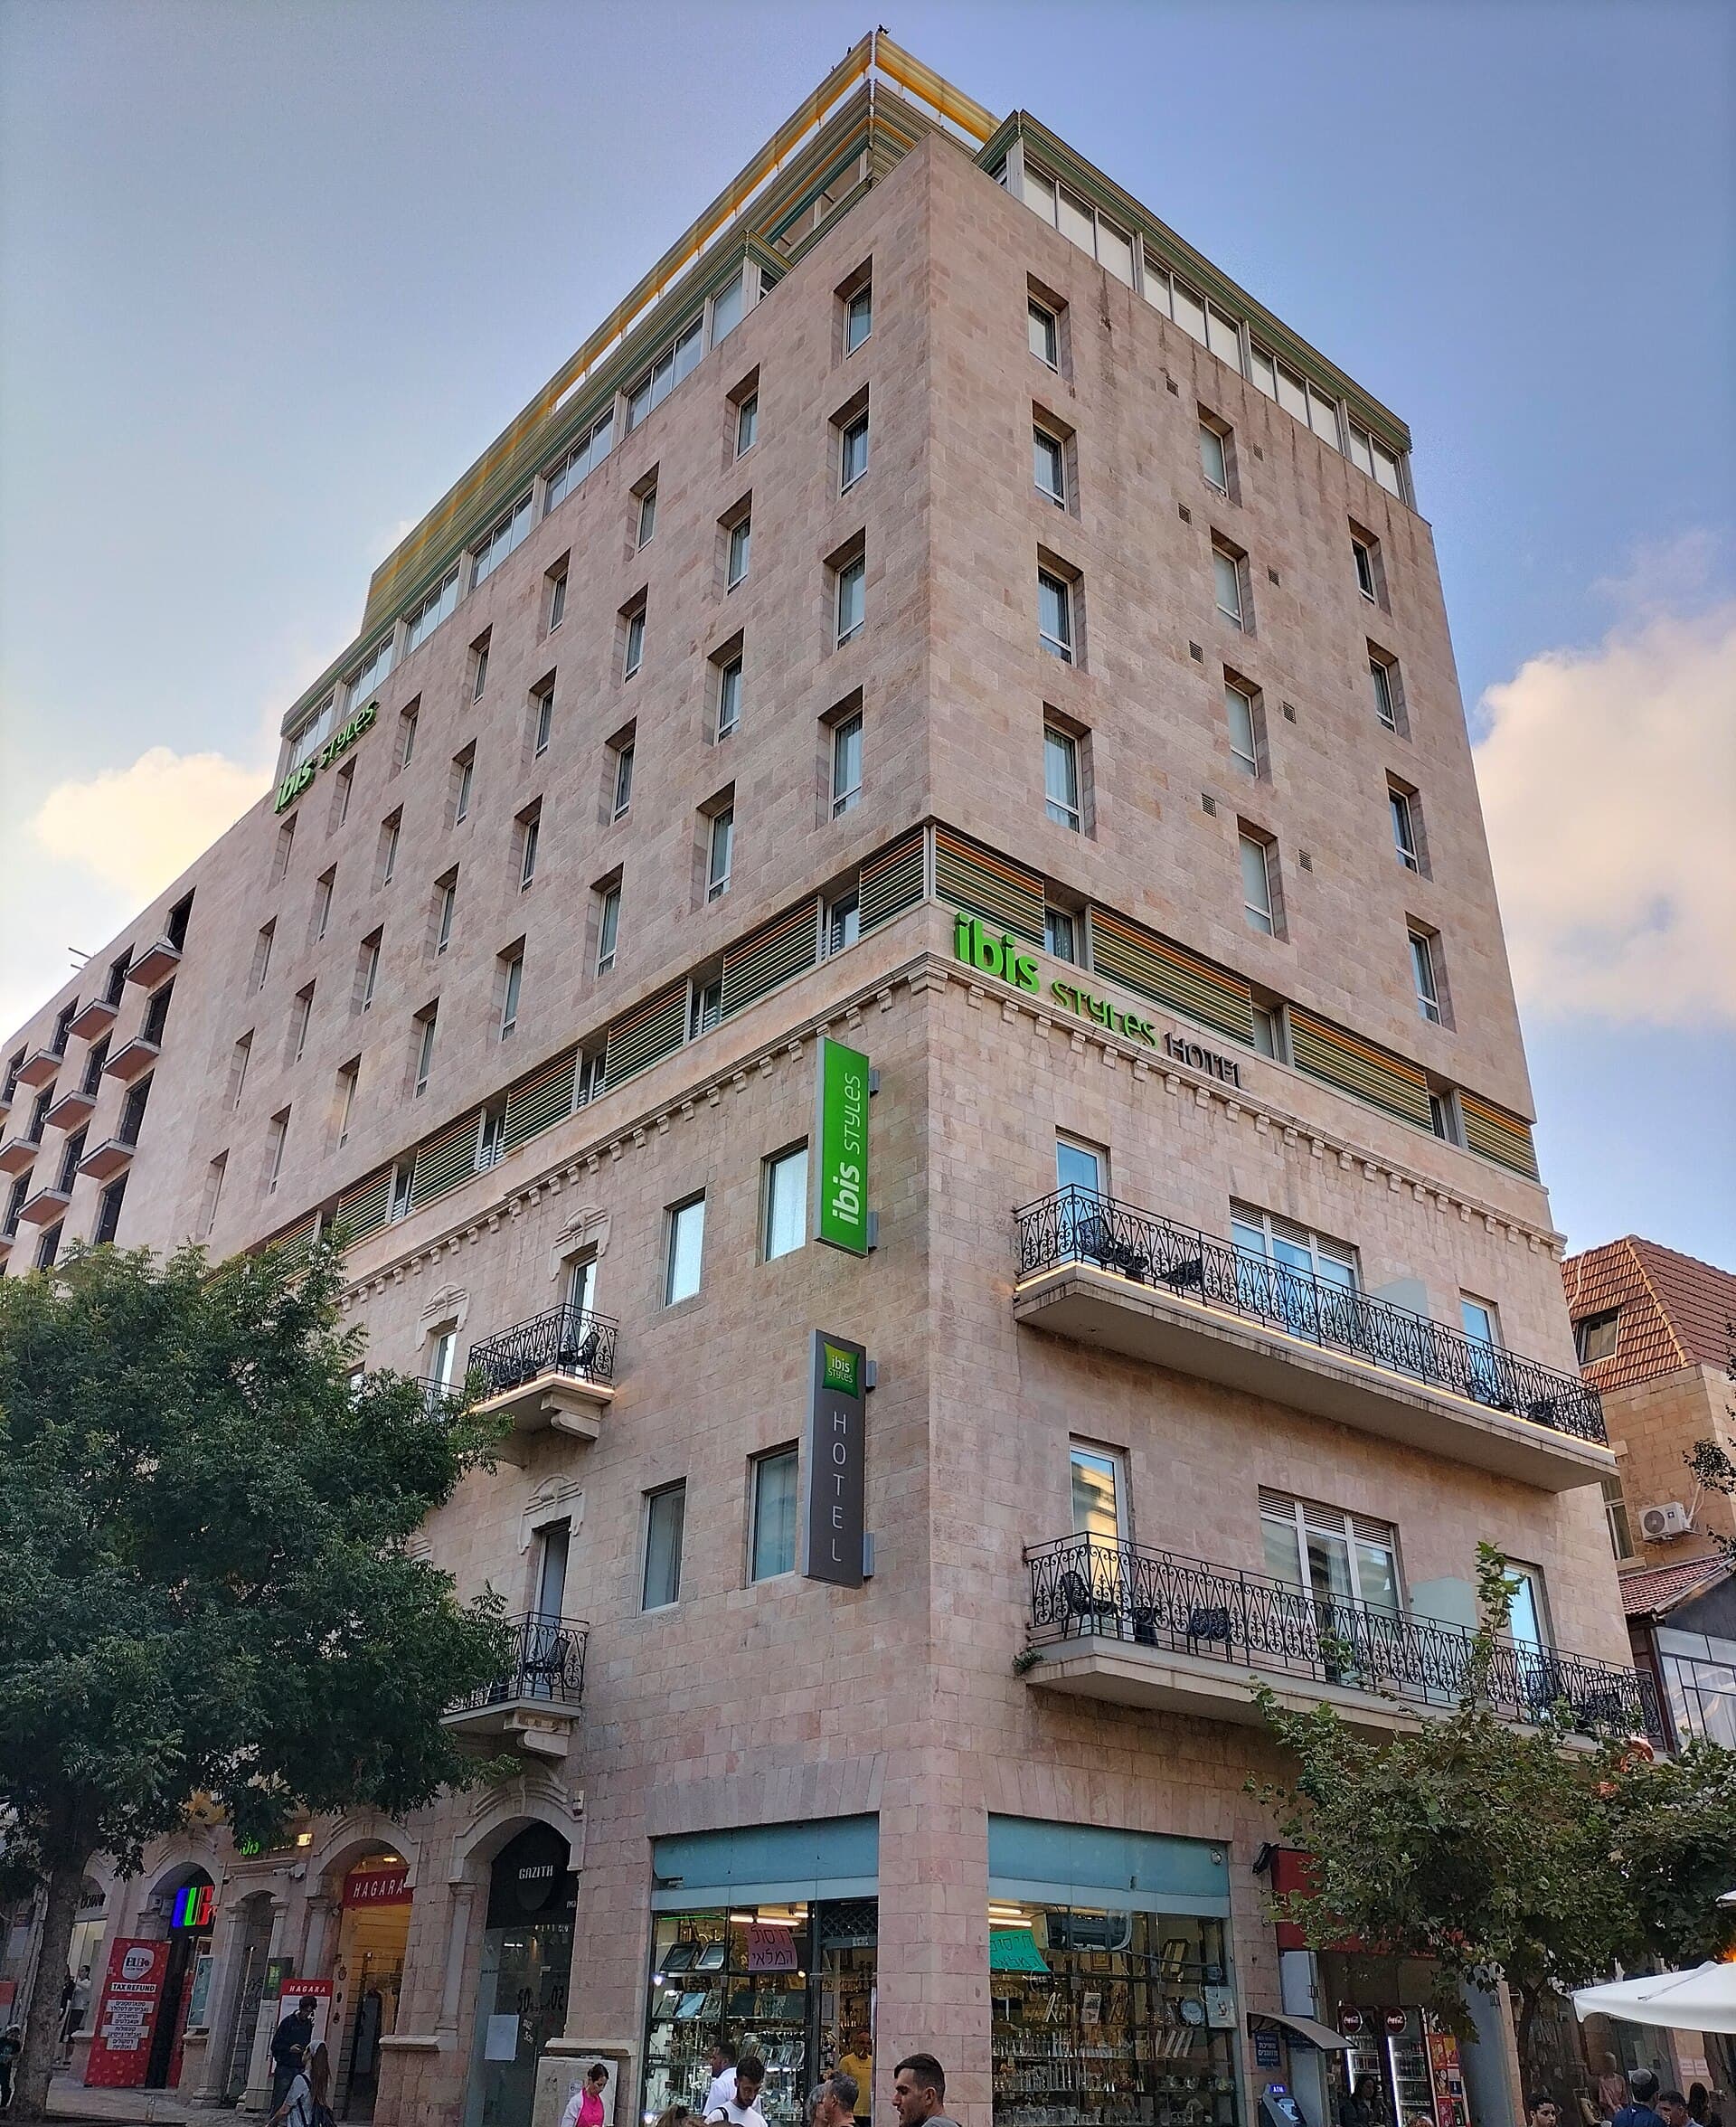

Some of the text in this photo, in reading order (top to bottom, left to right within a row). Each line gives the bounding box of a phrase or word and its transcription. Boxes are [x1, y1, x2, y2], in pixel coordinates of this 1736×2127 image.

[954, 912, 1041, 995] ibis
[1164, 1032, 1243, 1089] HOTEL
[832, 1162, 860, 1225] ibis
[832, 1355, 850, 1373] ibis
[832, 1411, 847, 1563] HOTEL
[518, 1865, 554, 1880] GAZITH
[353, 1878, 404, 1898] HAGARA
[751, 1948, 793, 1966] המלאי
[127, 1984, 156, 1992] REFUND
[289, 1985, 326, 1993] HAGARA
